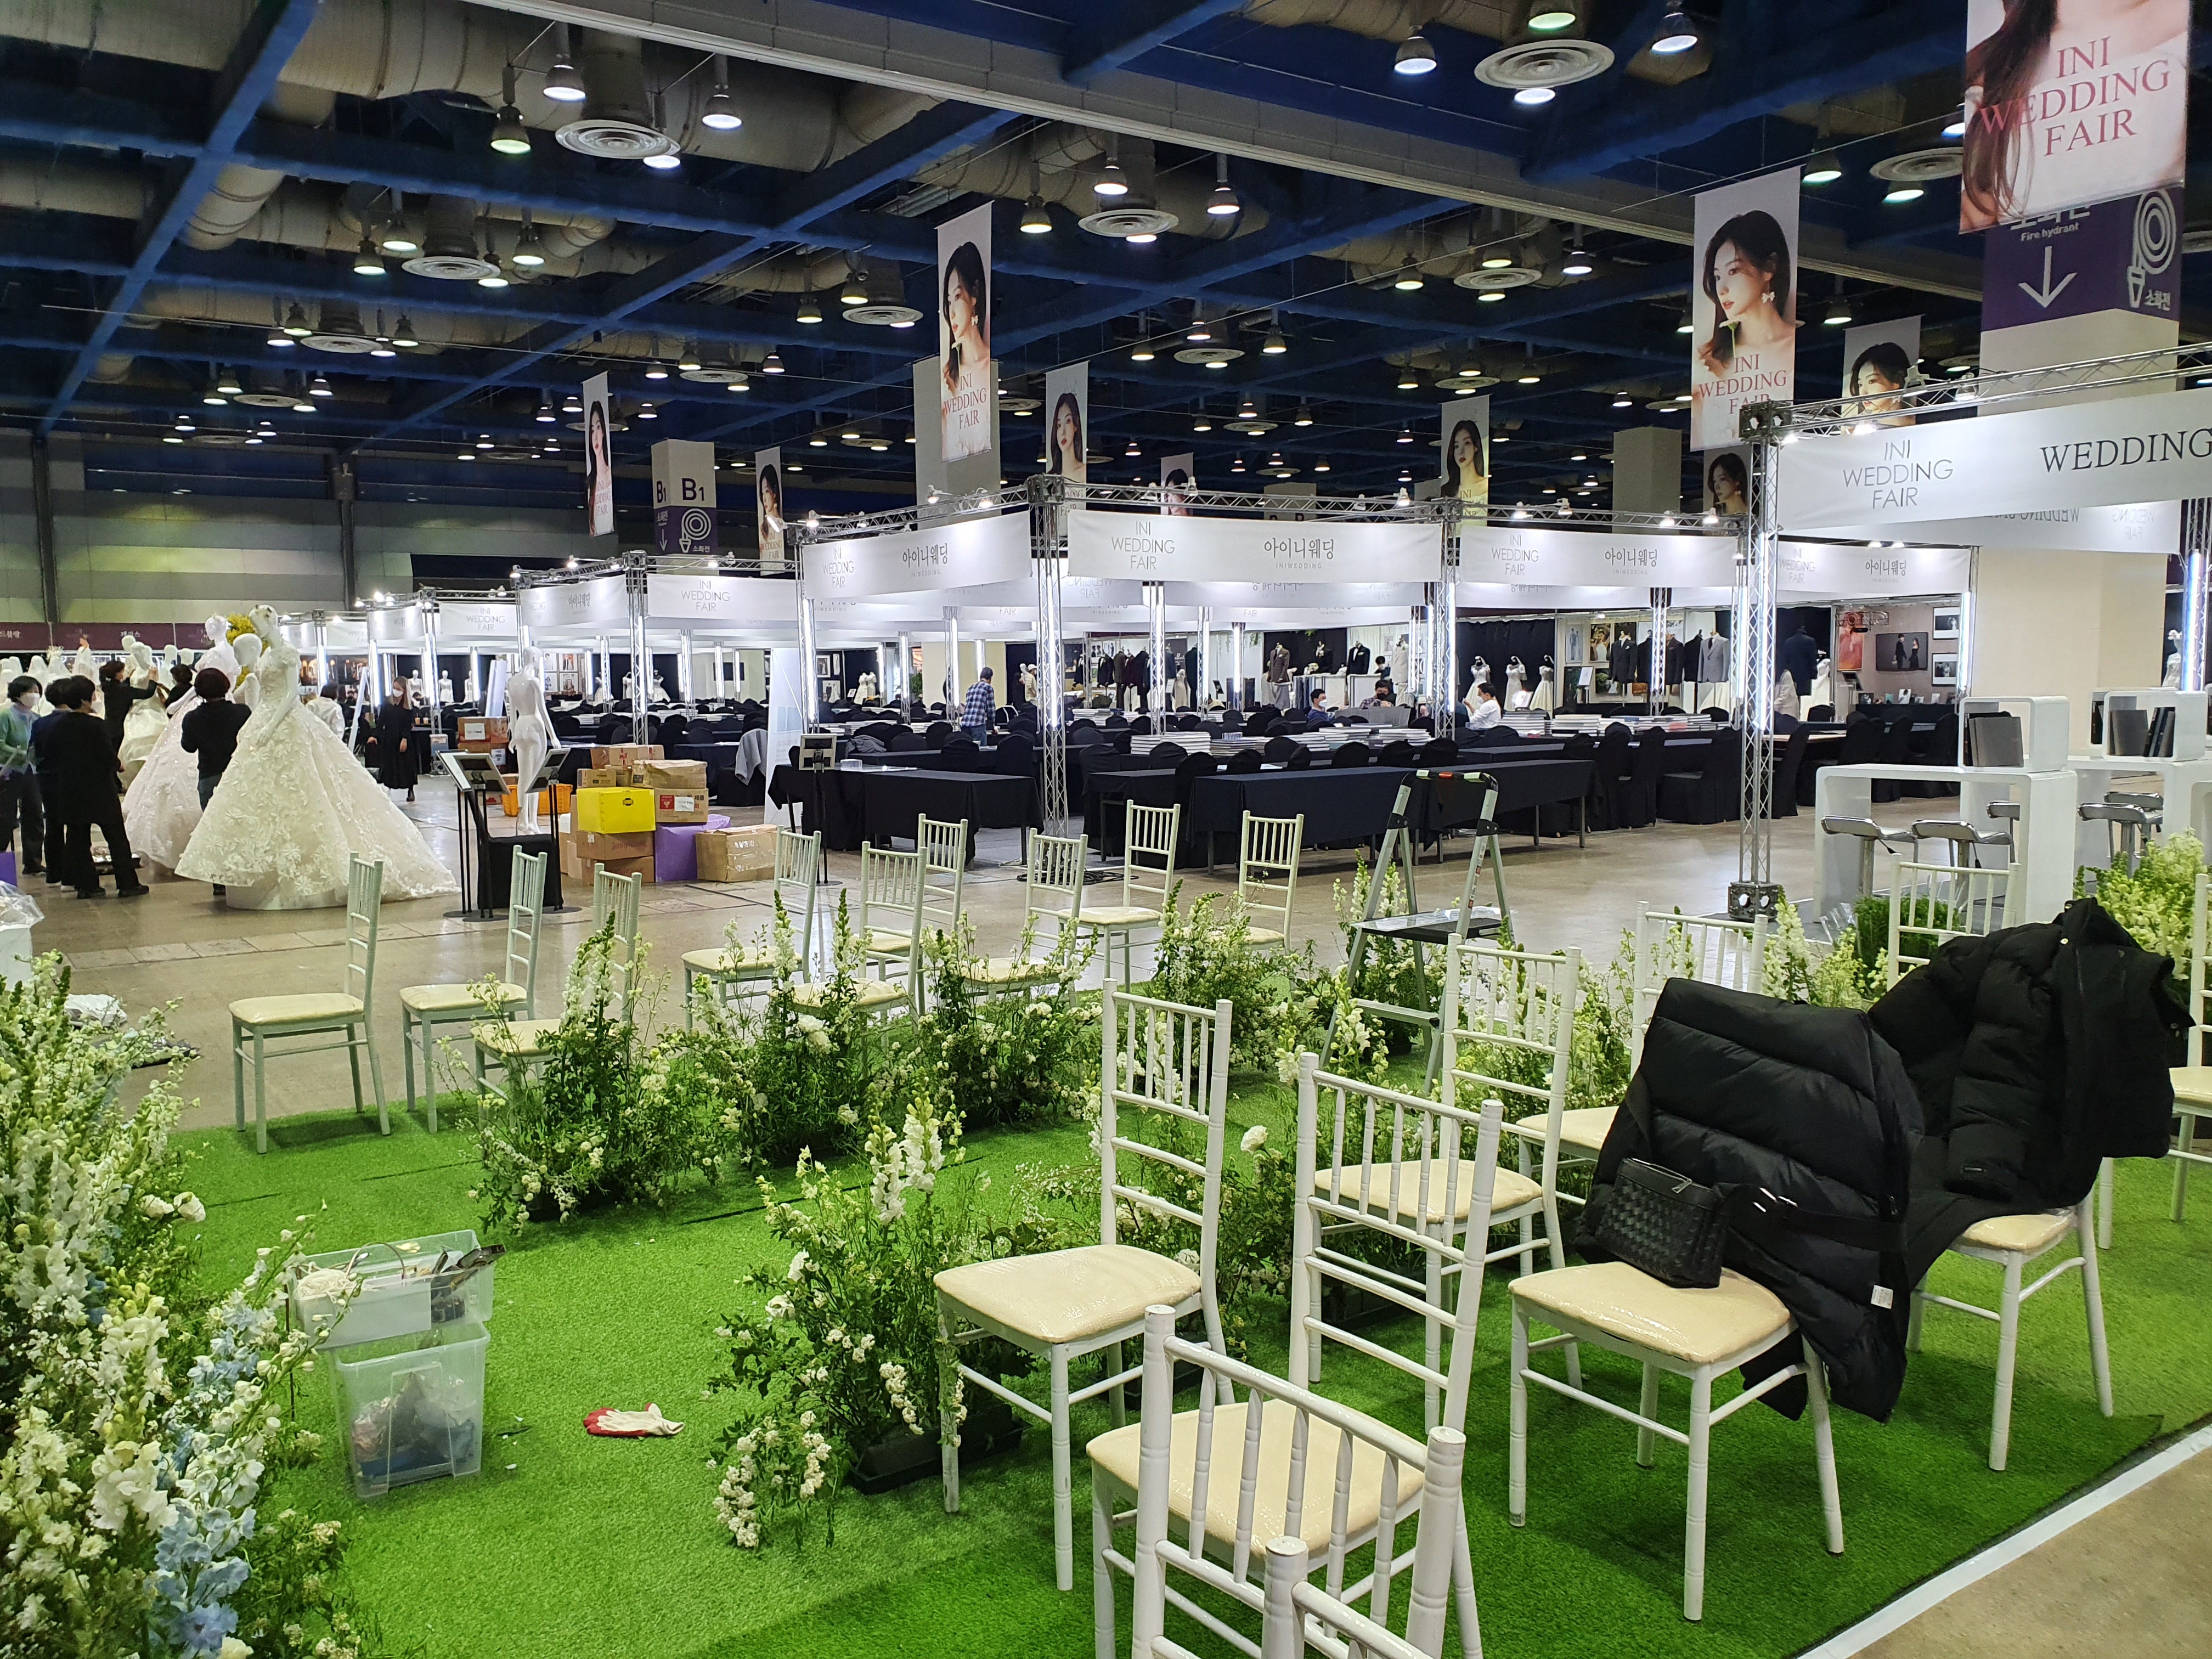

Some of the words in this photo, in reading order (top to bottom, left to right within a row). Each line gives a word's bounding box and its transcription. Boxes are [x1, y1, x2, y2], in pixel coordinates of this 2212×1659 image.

[2056, 35, 2112, 78] INI
[1979, 59, 2170, 134] WEDDING
[2044, 109, 2137, 156] FAIR
[2021, 230, 2040, 241] Fire
[2041, 221, 2080, 239] hydrant
[1734, 354, 1760, 374] INI
[960, 373, 973, 391] INI
[1699, 369, 1787, 399] WEDDING
[944, 387, 987, 415] WEDDING
[958, 409, 980, 430] FAIR
[1884, 439, 1910, 461] INI
[2040, 427, 2212, 473] WEDDING
[1843, 459, 1954, 487] WEDDING
[656, 481, 667, 504] B1
[682, 478, 704, 501] B1
[1872, 487, 1918, 509] FAIR
[1136, 521, 1151, 536] INI
[1111, 537, 1175, 554] WEDDING
[1264, 537, 1334, 560] 아이니웨딩
[1510, 534, 1522, 547] INI
[833, 546, 842, 560] INI
[902, 543, 949, 569] 아이니웨딩
[1131, 555, 1157, 570] FAIR
[1491, 548, 1539, 562] WEDDING
[1605, 548, 1658, 567] 아이니웨딩
[822, 560, 854, 575] WEDDING
[1505, 563, 1525, 576] FAIR
[1779, 558, 1815, 572] WEDDING
[1865, 559, 1907, 577] 아이니웨딩
[699, 580, 712, 590] INI
[832, 576, 845, 589] FAIR
[681, 590, 731, 601] WEDDING
[696, 602, 716, 612] FAIR
[466, 615, 505, 623] WEDDING
